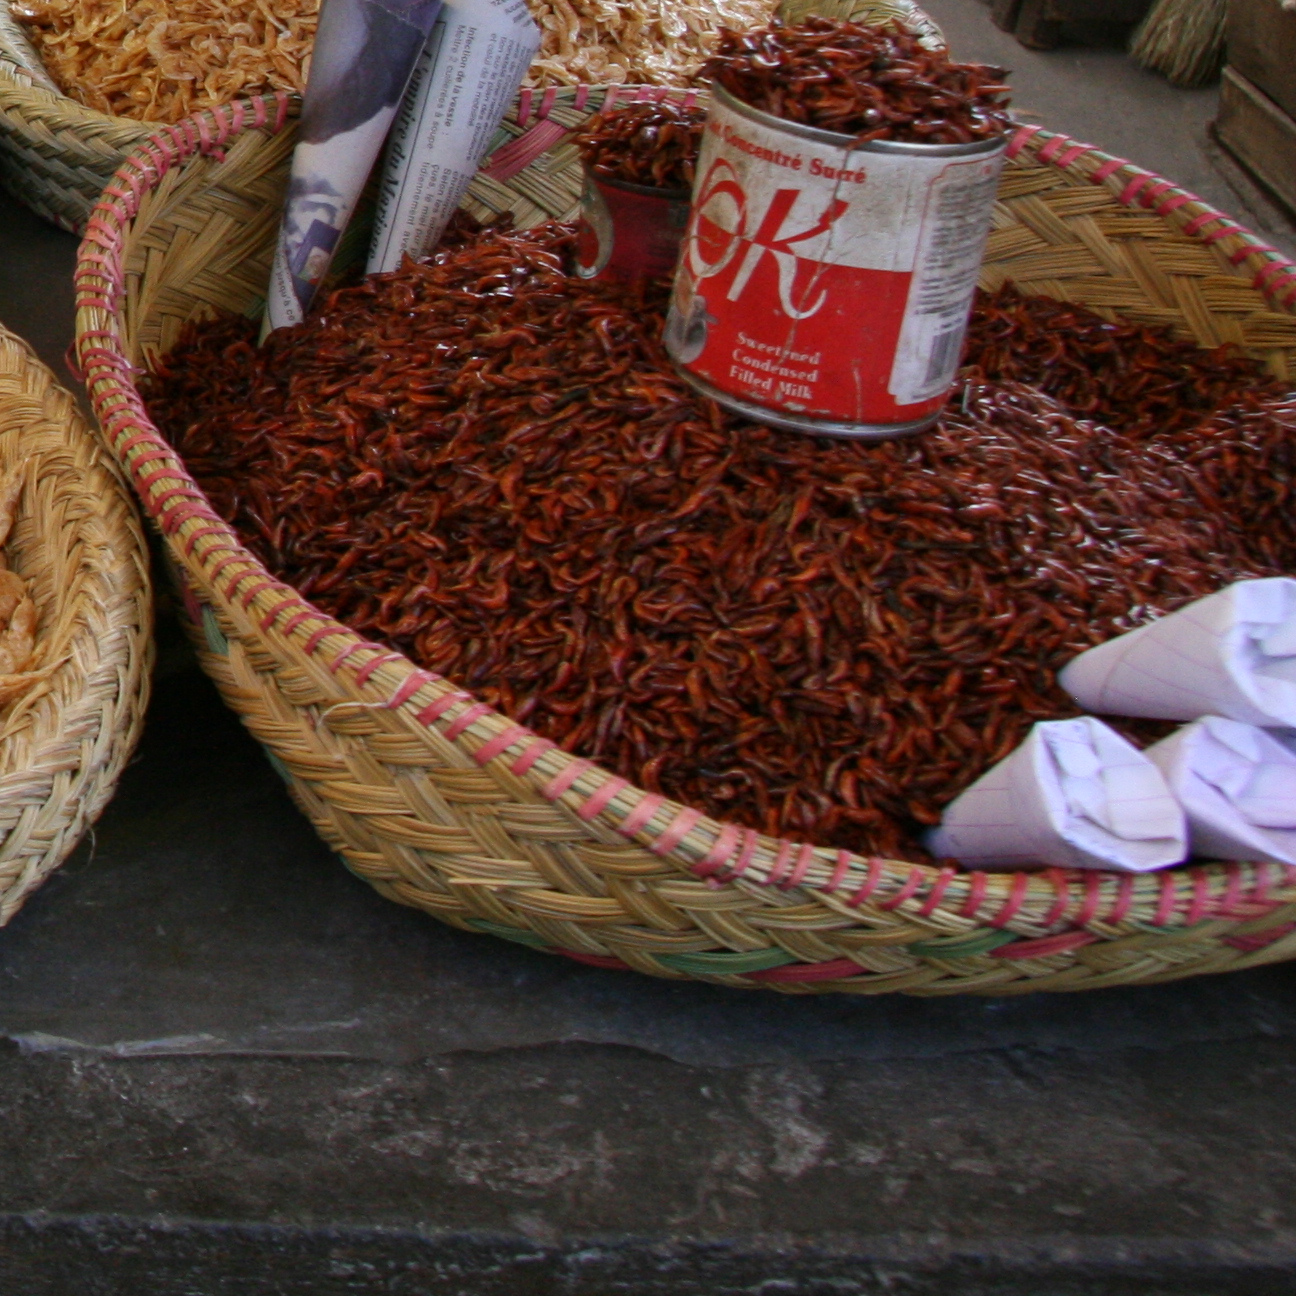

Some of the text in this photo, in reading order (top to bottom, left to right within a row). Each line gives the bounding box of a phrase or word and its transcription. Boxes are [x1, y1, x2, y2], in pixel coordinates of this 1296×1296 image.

[457, 25, 478, 69] Infection
[442, 95, 461, 128] vessie
[424, 120, 440, 149] soupe
[809, 157, 867, 185] Sucré
[686, 158, 849, 320] OK
[735, 331, 822, 365] Sweetened
[728, 364, 813, 400] Filled Milk
[731, 348, 820, 383] Condensed
